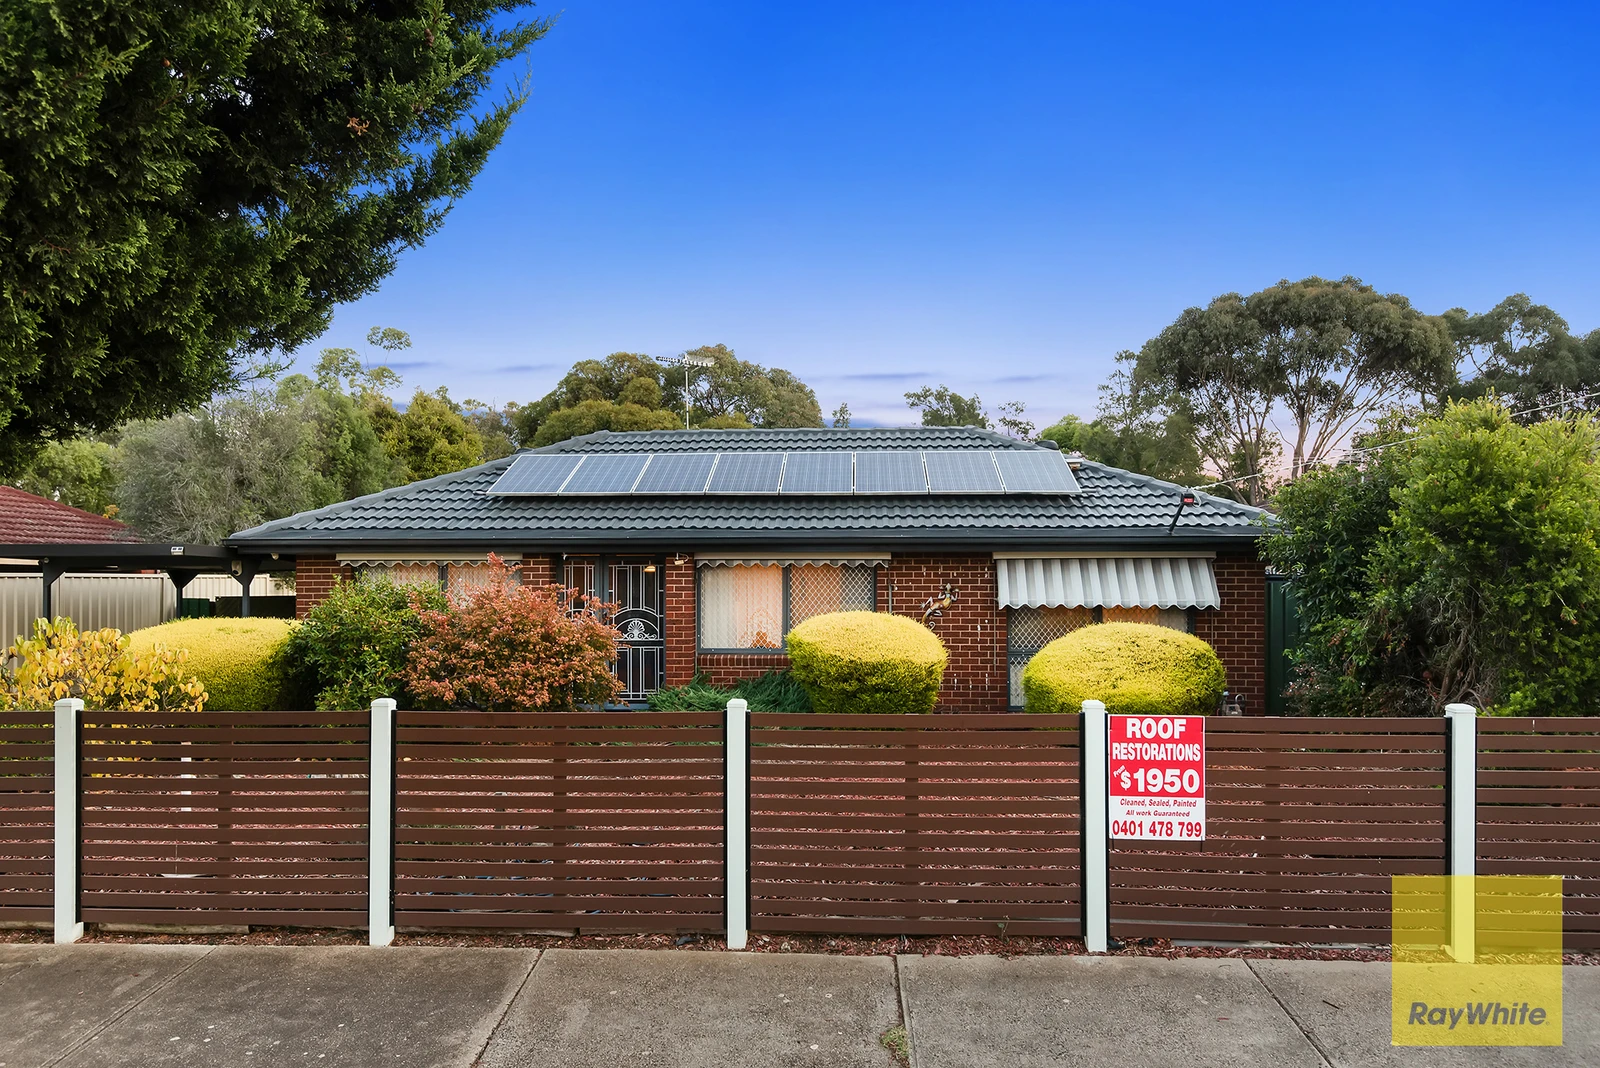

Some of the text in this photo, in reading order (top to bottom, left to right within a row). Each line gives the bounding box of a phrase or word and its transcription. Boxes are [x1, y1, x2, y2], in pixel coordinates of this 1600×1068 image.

[1126, 717, 1187, 739] ROOF
[1112, 742, 1201, 762] RESTORATIONS
[1120, 768, 1200, 794] $1950
[1120, 798, 1197, 808] Cleaned, Sealed, Painted
[1112, 820, 1202, 837] 0401 478 799
